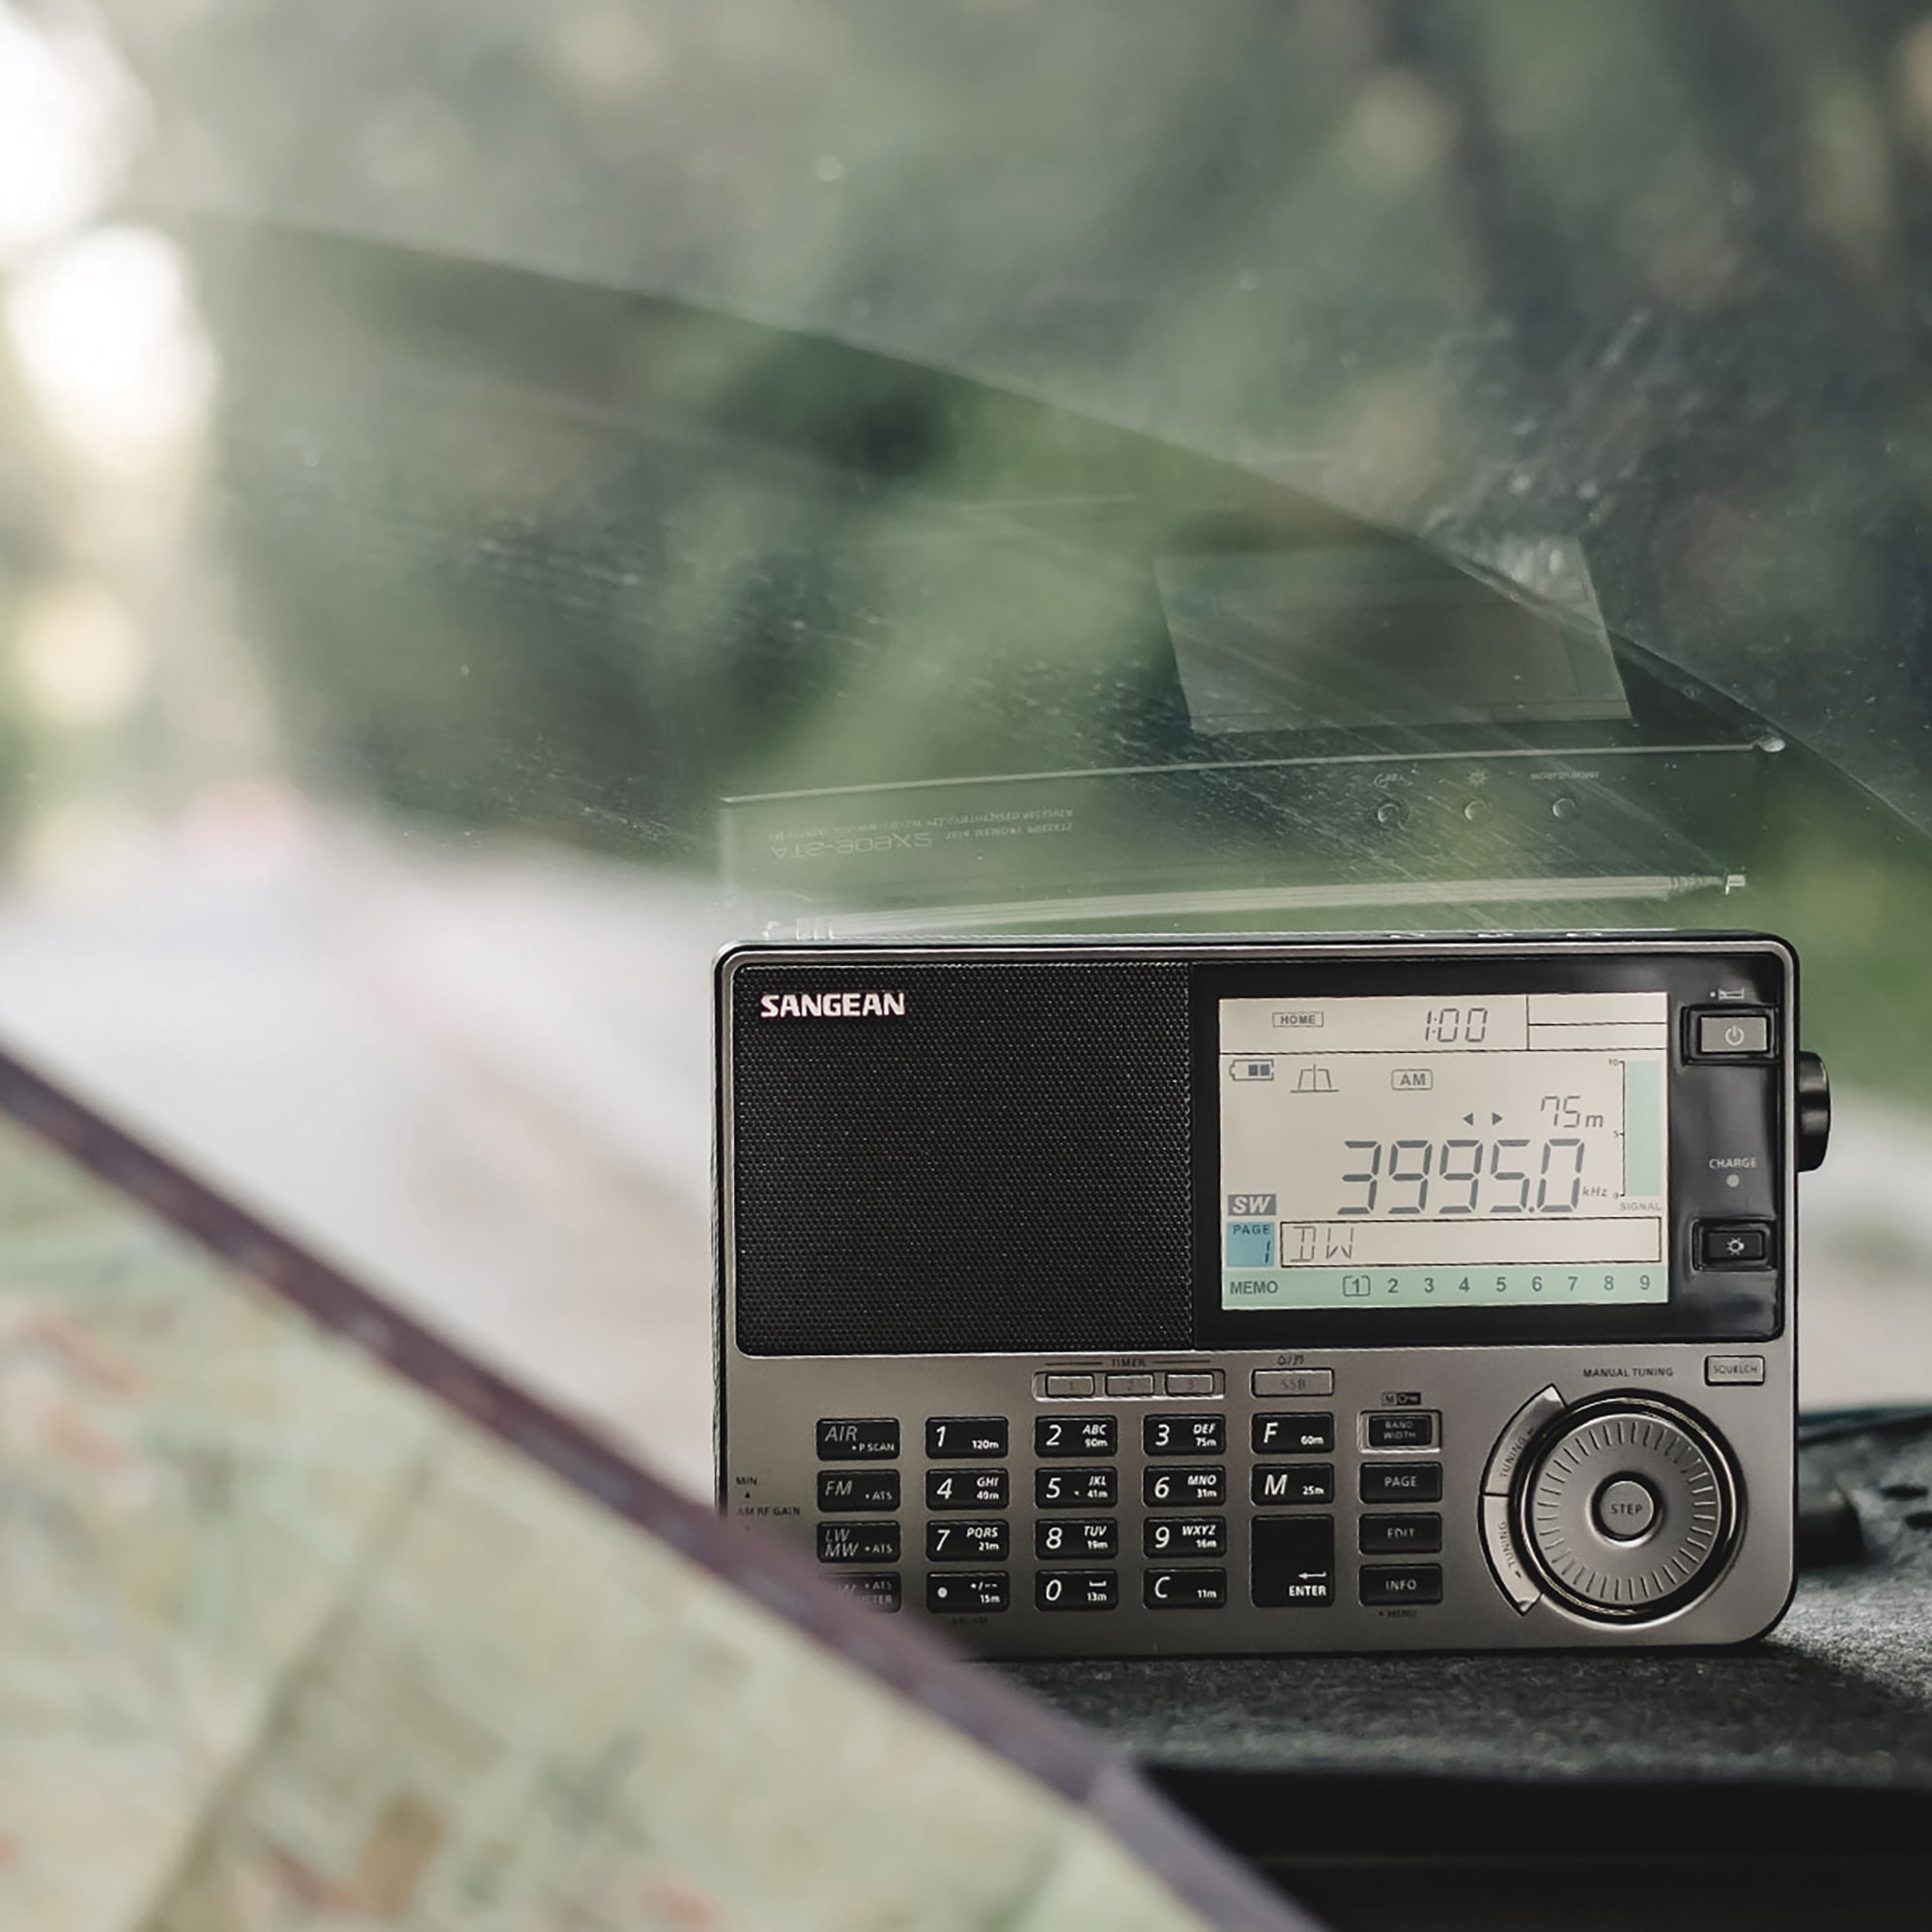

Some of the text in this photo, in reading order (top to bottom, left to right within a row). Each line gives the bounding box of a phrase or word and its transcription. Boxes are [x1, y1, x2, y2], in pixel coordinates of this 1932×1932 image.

[760, 992, 905, 1017] SANGEAN
[1280, 1014, 1316, 1025] HOME
[1425, 1008, 1488, 1042] 1:00
[1400, 1073, 1426, 1086] AM
[1541, 1095, 1604, 1128] 75m
[1709, 1157, 1756, 1169] CHARGE
[1337, 1138, 1608, 1215] 3995.0 kHz
[1232, 1195, 1271, 1214] SW
[1619, 1201, 1662, 1212] SIGNAL
[1233, 1223, 1271, 1236] PAGE
[1290, 1225, 1354, 1263] DW
[1264, 1239, 1271, 1264] 1
[1230, 1274, 1650, 1294] MEMO 1 2 3 4 5 6 7 8 9
[1112, 1358, 1147, 1368] TIMER
[1582, 1367, 1674, 1378] MANUAL TUNING
[1713, 1364, 1758, 1375] SQUELCH
[1281, 1378, 1306, 1390] SSB
[1082, 1424, 1107, 1435] ABC
[1193, 1423, 1216, 1435] DEF
[1385, 1421, 1413, 1430] BAND
[825, 1425, 858, 1442] AIR
[935, 1426, 947, 1447] 1
[1045, 1424, 1063, 1446] 2
[1155, 1424, 1170, 1446] 3
[1264, 1422, 1279, 1443] F
[1383, 1431, 1416, 1440] WIDTH
[972, 1439, 1000, 1450] 120m
[1195, 1437, 1217, 1447] 75m
[1300, 1435, 1324, 1446] 60m
[1498, 1435, 1526, 1478] TUNING
[736, 1476, 757, 1486] MIN
[977, 1476, 1000, 1488] GHI
[1089, 1475, 1107, 1486] JKL
[1187, 1475, 1217, 1486] MNO
[1264, 1474, 1290, 1495] M
[1384, 1476, 1417, 1488] PAGE
[825, 1480, 853, 1496] FM
[936, 1478, 953, 1499] 4
[1045, 1477, 1062, 1498] 5
[1154, 1476, 1170, 1498] 6
[1302, 1485, 1324, 1495] 25m
[872, 1492, 893, 1500] ATS
[976, 1491, 1000, 1500] 49m
[1087, 1489, 1108, 1498] 41m
[1197, 1489, 1217, 1498] 31m
[756, 1507, 770, 1516] RF
[773, 1506, 801, 1516] GAIN
[1609, 1503, 1643, 1516] STEP
[825, 1528, 850, 1543] LW
[966, 1526, 999, 1538] PQRS
[1084, 1525, 1107, 1537] TUV
[1181, 1524, 1217, 1536] WXYZ
[1386, 1527, 1416, 1539] EDIT
[936, 1529, 951, 1550] 7
[1045, 1526, 1063, 1549] 8
[1154, 1526, 1171, 1548] 9
[872, 1544, 893, 1553] ATS
[978, 1542, 1000, 1551] 21m
[1195, 1539, 1217, 1548] 16m
[1498, 1521, 1517, 1570] TUNING
[825, 1543, 859, 1557] MW
[872, 1581, 893, 1590] ATS
[1045, 1578, 1062, 1602] 0
[1154, 1577, 1171, 1599] C
[1288, 1584, 1327, 1597] ENTER
[1385, 1578, 1417, 1591] INFO
[980, 1595, 1001, 1604] 15m
[1087, 1592, 1107, 1602] 13m
[1197, 1589, 1217, 1599] 11m
